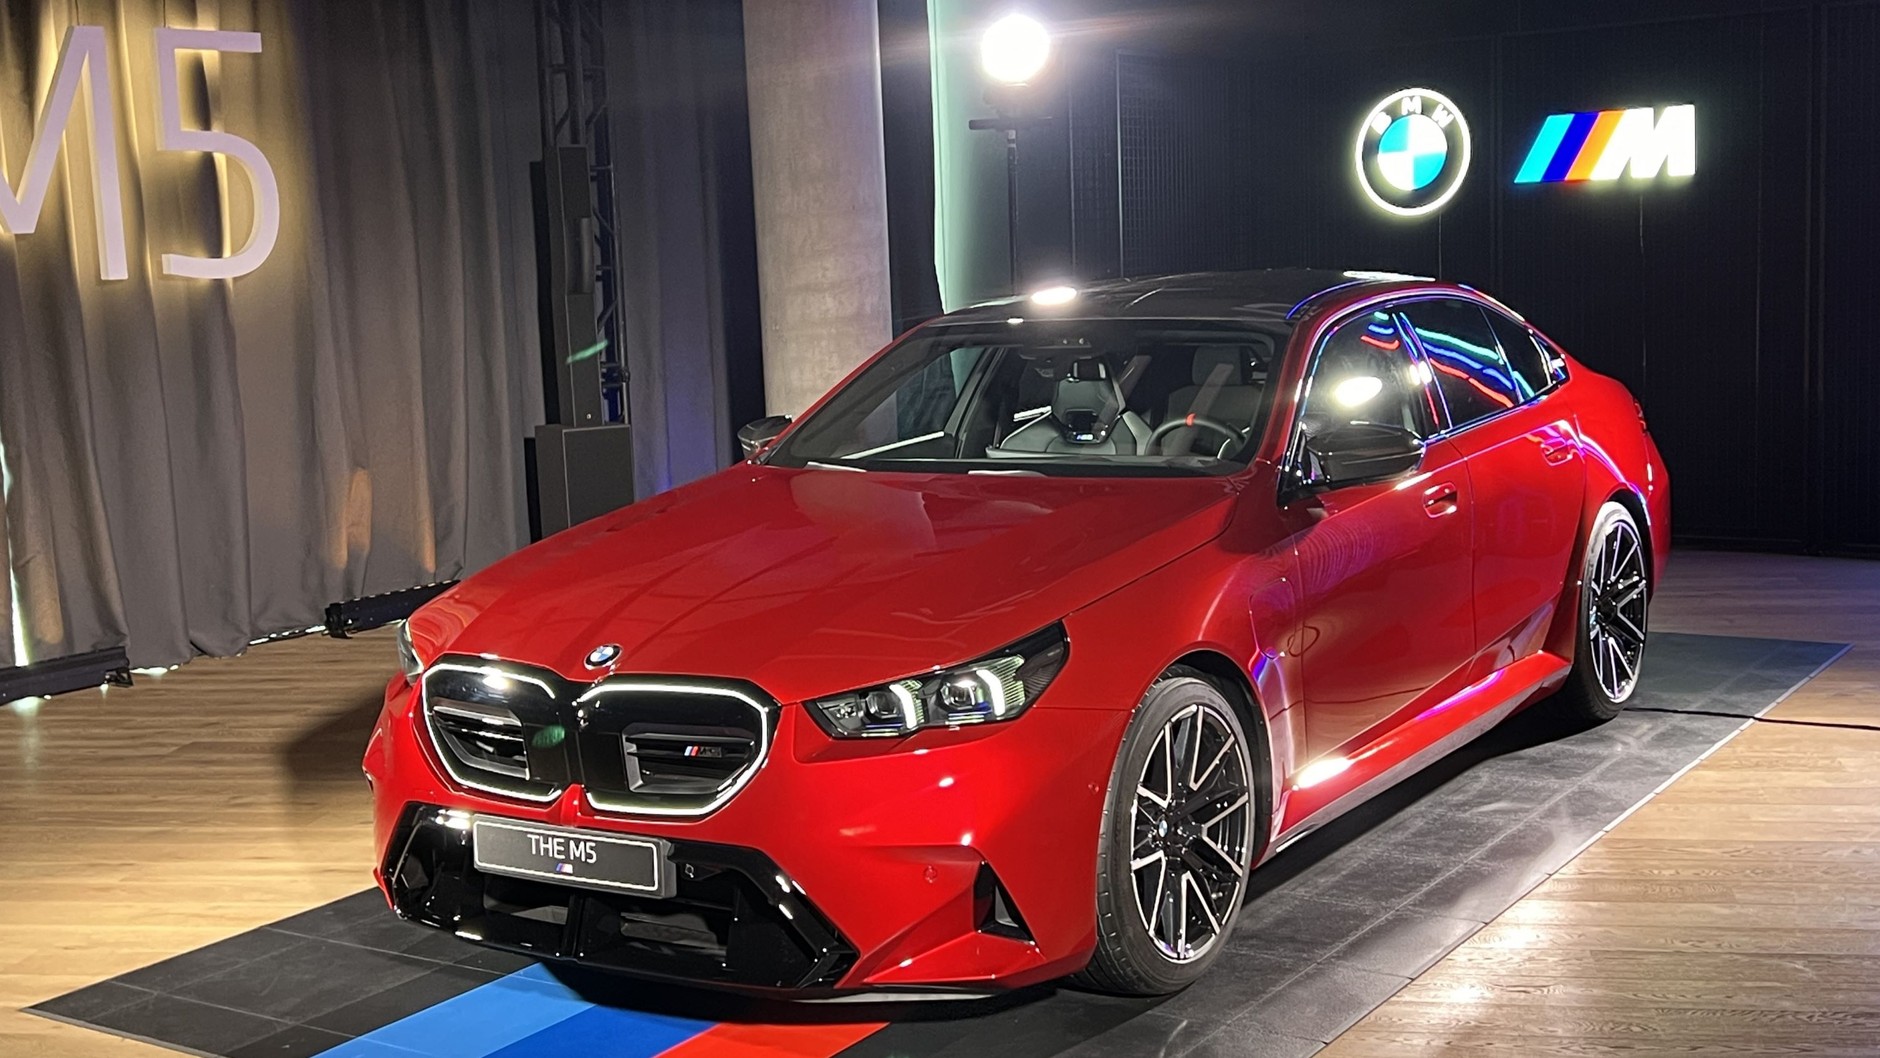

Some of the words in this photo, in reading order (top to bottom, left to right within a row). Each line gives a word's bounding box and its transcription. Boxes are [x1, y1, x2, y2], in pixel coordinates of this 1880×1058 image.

[1370, 95, 1455, 136] BMW
[526, 833, 565, 860] THE
[568, 839, 597, 864] M5
